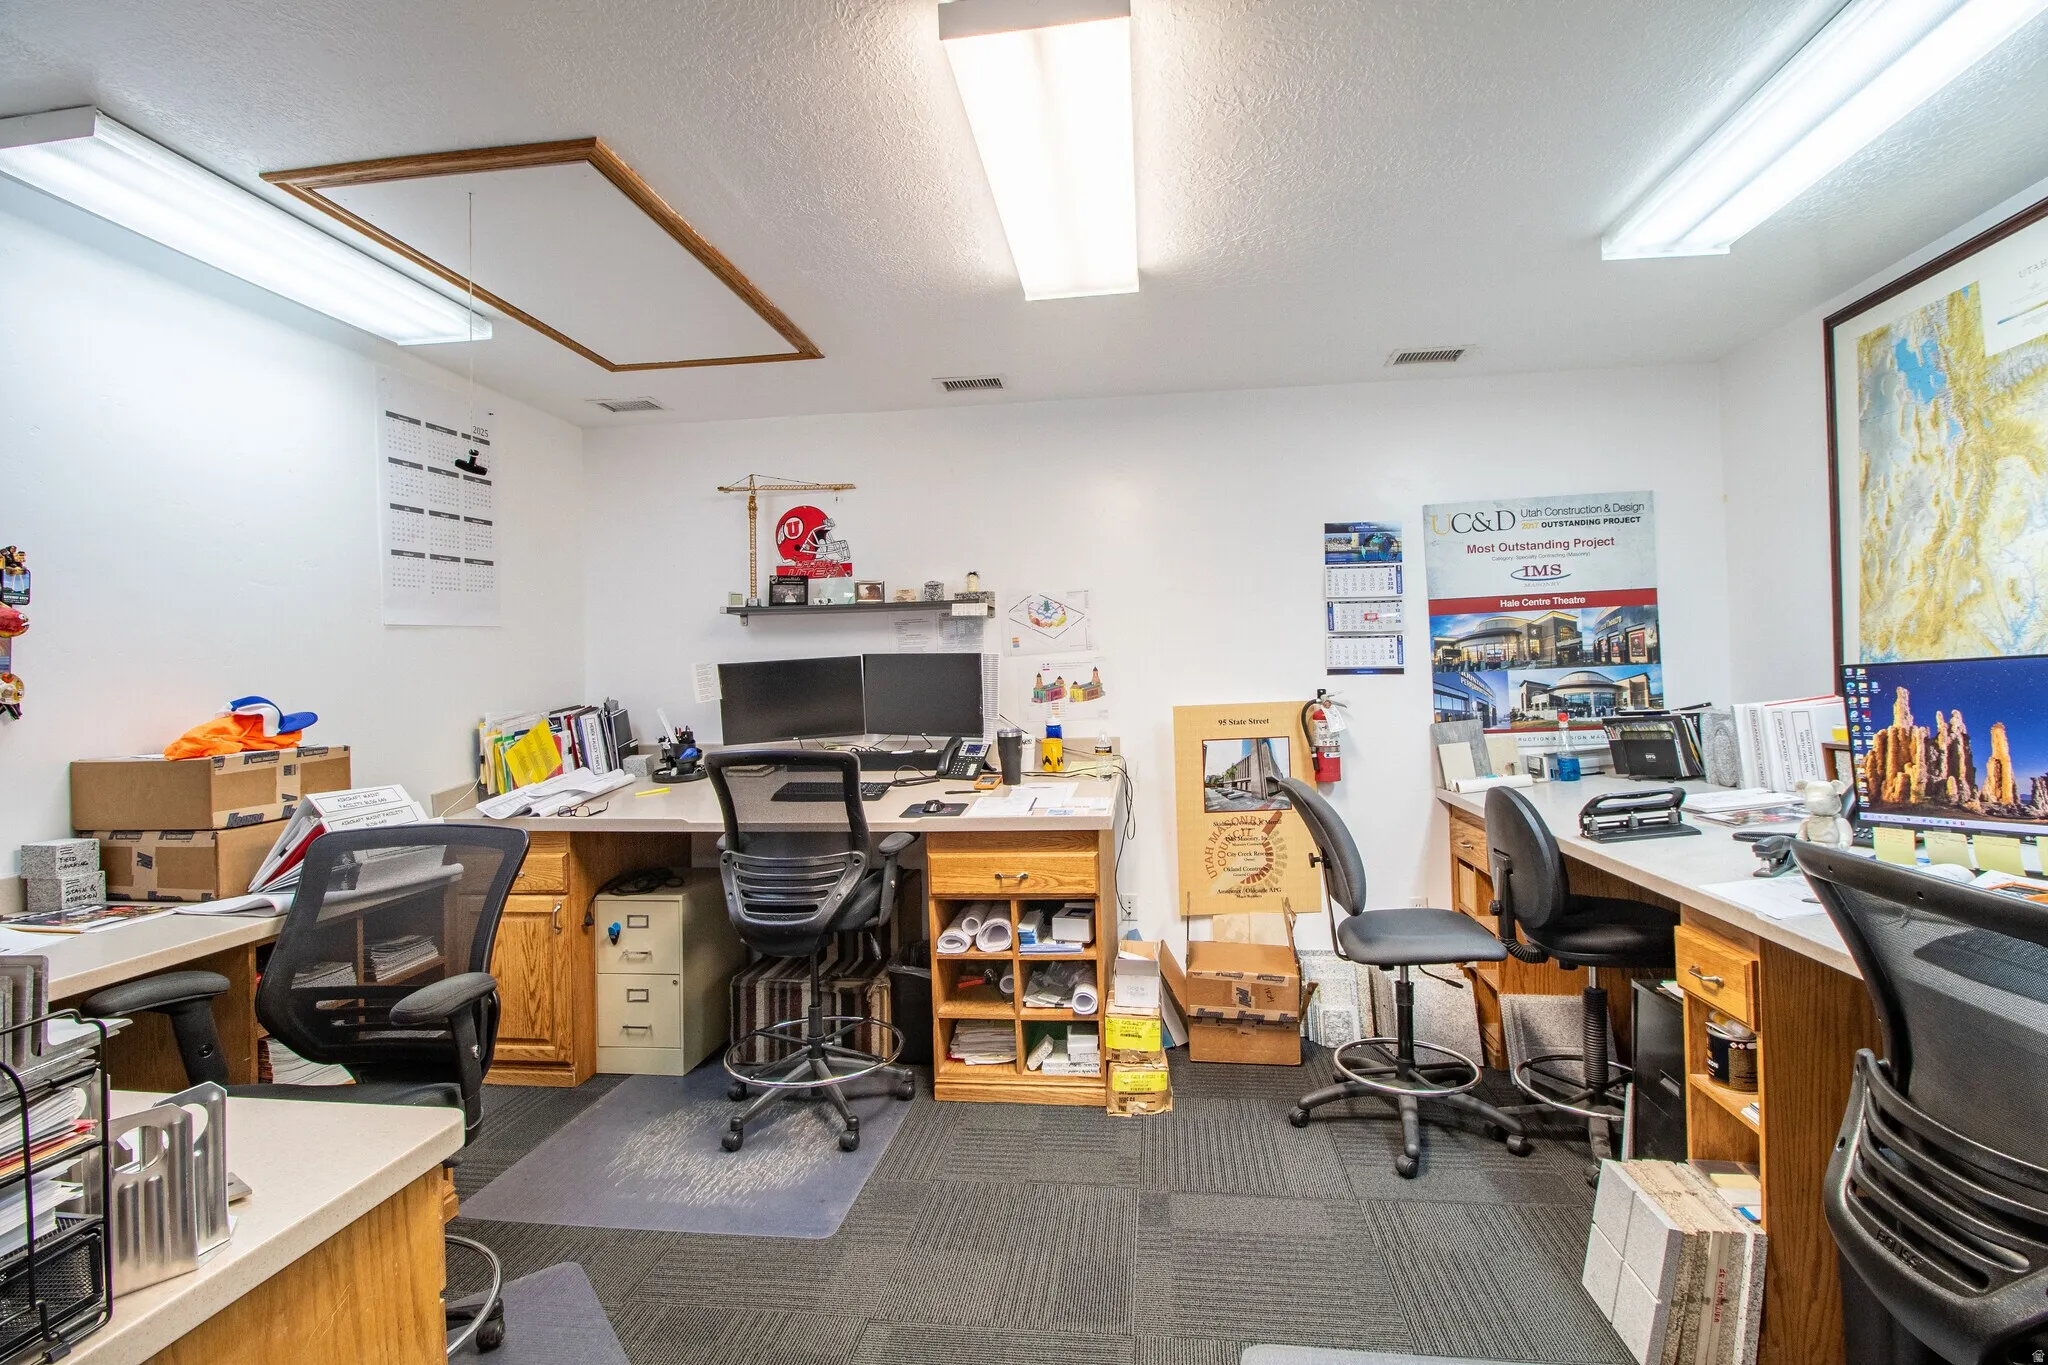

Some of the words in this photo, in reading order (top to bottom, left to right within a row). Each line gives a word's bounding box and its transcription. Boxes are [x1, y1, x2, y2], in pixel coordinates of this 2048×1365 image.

[472, 426, 488, 437] 2025
[1520, 508, 1542, 518] Utah
[1544, 505, 1602, 516] Construction
[1604, 504, 1610, 513] &
[1612, 502, 1645, 513] Design
[786, 520, 800, 536] U
[1431, 510, 1516, 536] UC&D
[1541, 519, 1601, 528] OUTSTANDING
[1603, 516, 1641, 525] PROJECT
[1467, 544, 1495, 554] Most
[1498, 540, 1570, 552] Outstanding
[1574, 537, 1615, 549] Project
[788, 567, 839, 577] UTES
[1522, 564, 1562, 577] IMS
[1500, 599, 1520, 607] Hale
[1522, 598, 1550, 606] Centre
[1552, 596, 1586, 605] Theatre
[341, 817, 364, 826] AIRCRAFT
[1208, 815, 1265, 844] MASONRY
[1217, 829, 1253, 867] COUNCIL
[1204, 846, 1218, 879] UTAH
